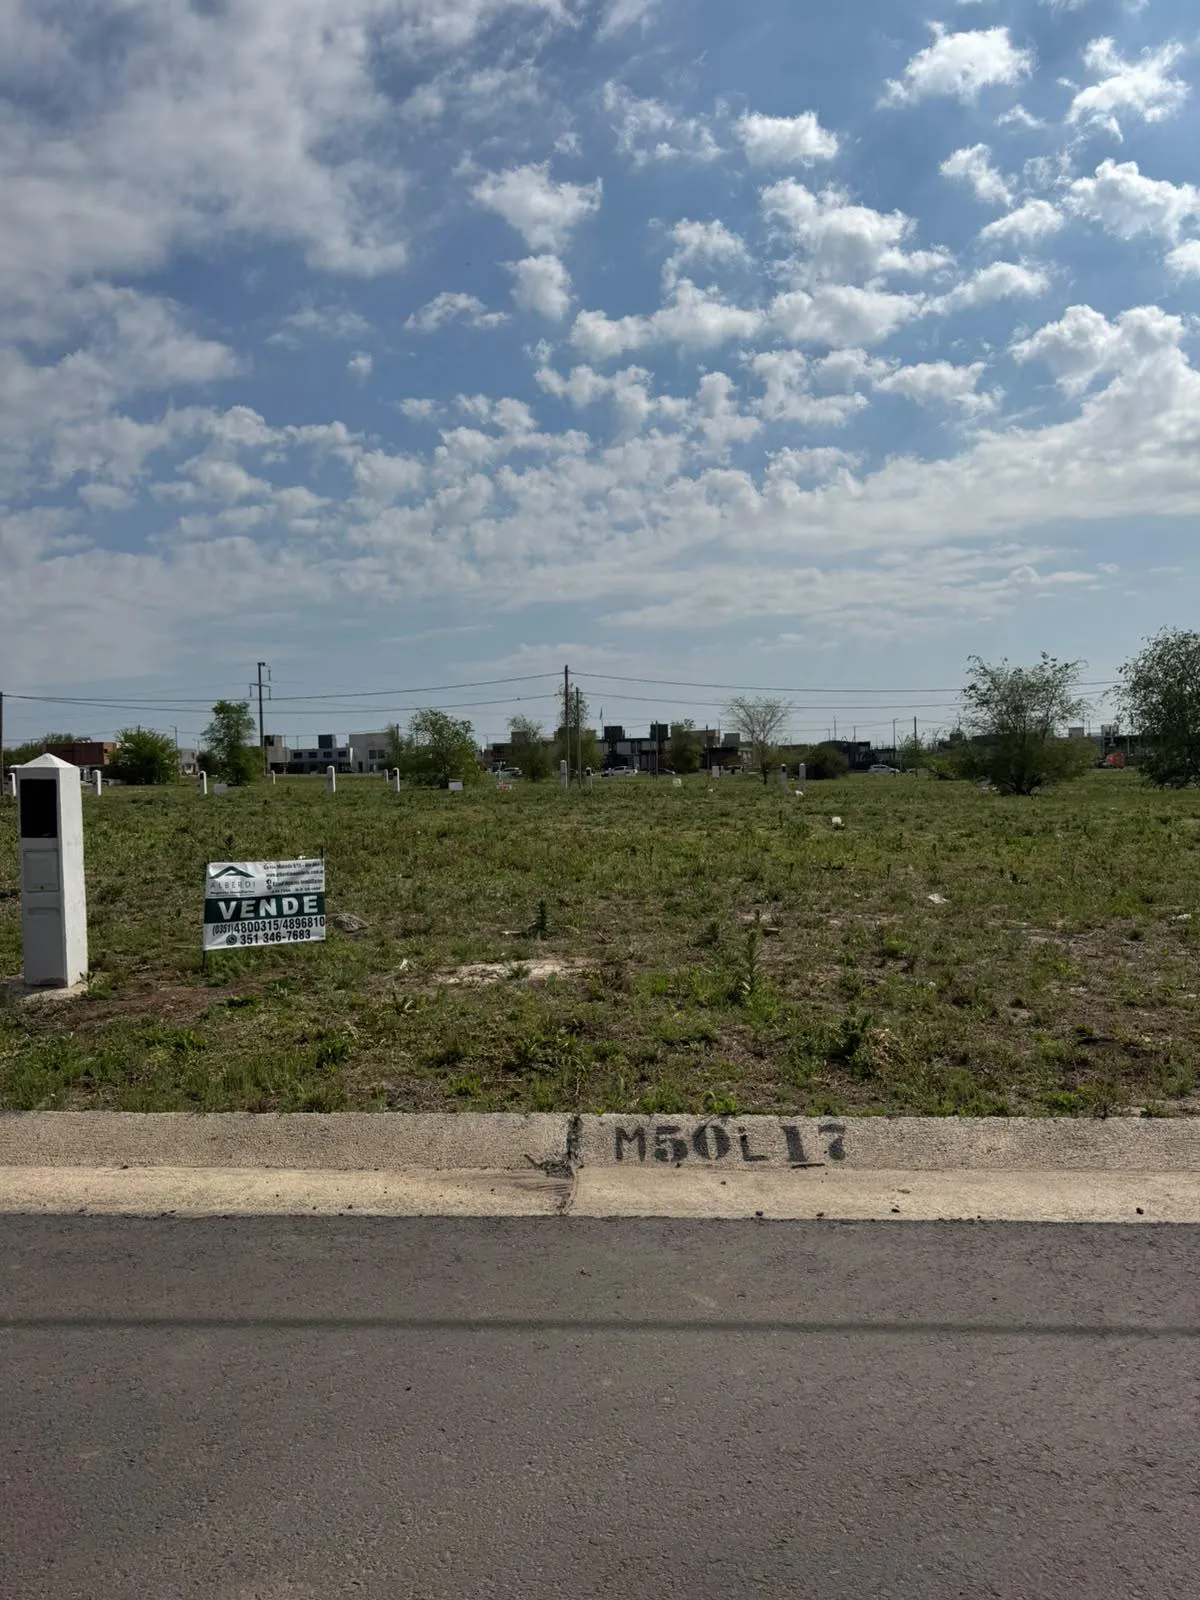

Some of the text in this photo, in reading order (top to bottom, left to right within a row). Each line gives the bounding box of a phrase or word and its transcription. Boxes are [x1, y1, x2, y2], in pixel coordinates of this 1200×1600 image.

[218, 895, 318, 920] VENDE
[240, 930, 311, 945] 351 346-7683
